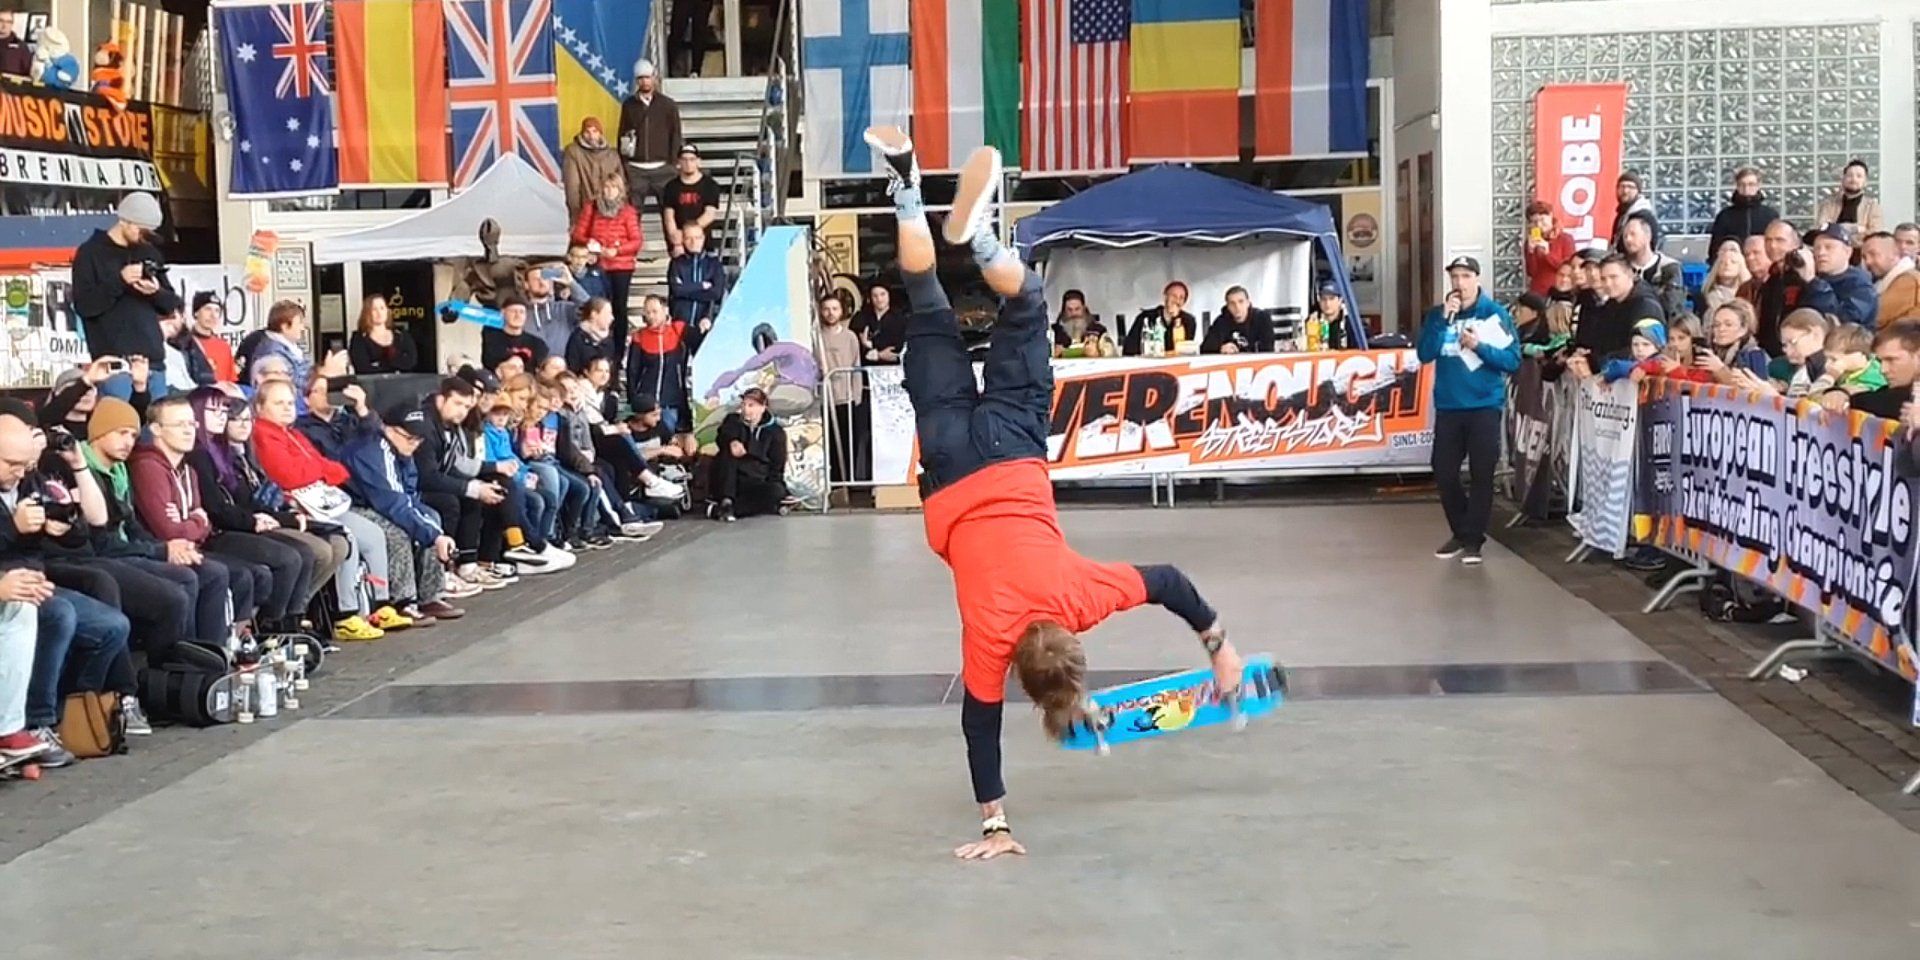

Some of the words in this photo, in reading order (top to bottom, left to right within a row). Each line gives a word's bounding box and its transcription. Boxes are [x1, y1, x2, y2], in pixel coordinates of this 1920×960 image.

[0, 91, 67, 141] MUSIC
[1680, 390, 1778, 489] European
[1784, 406, 1912, 558] Freestyle
